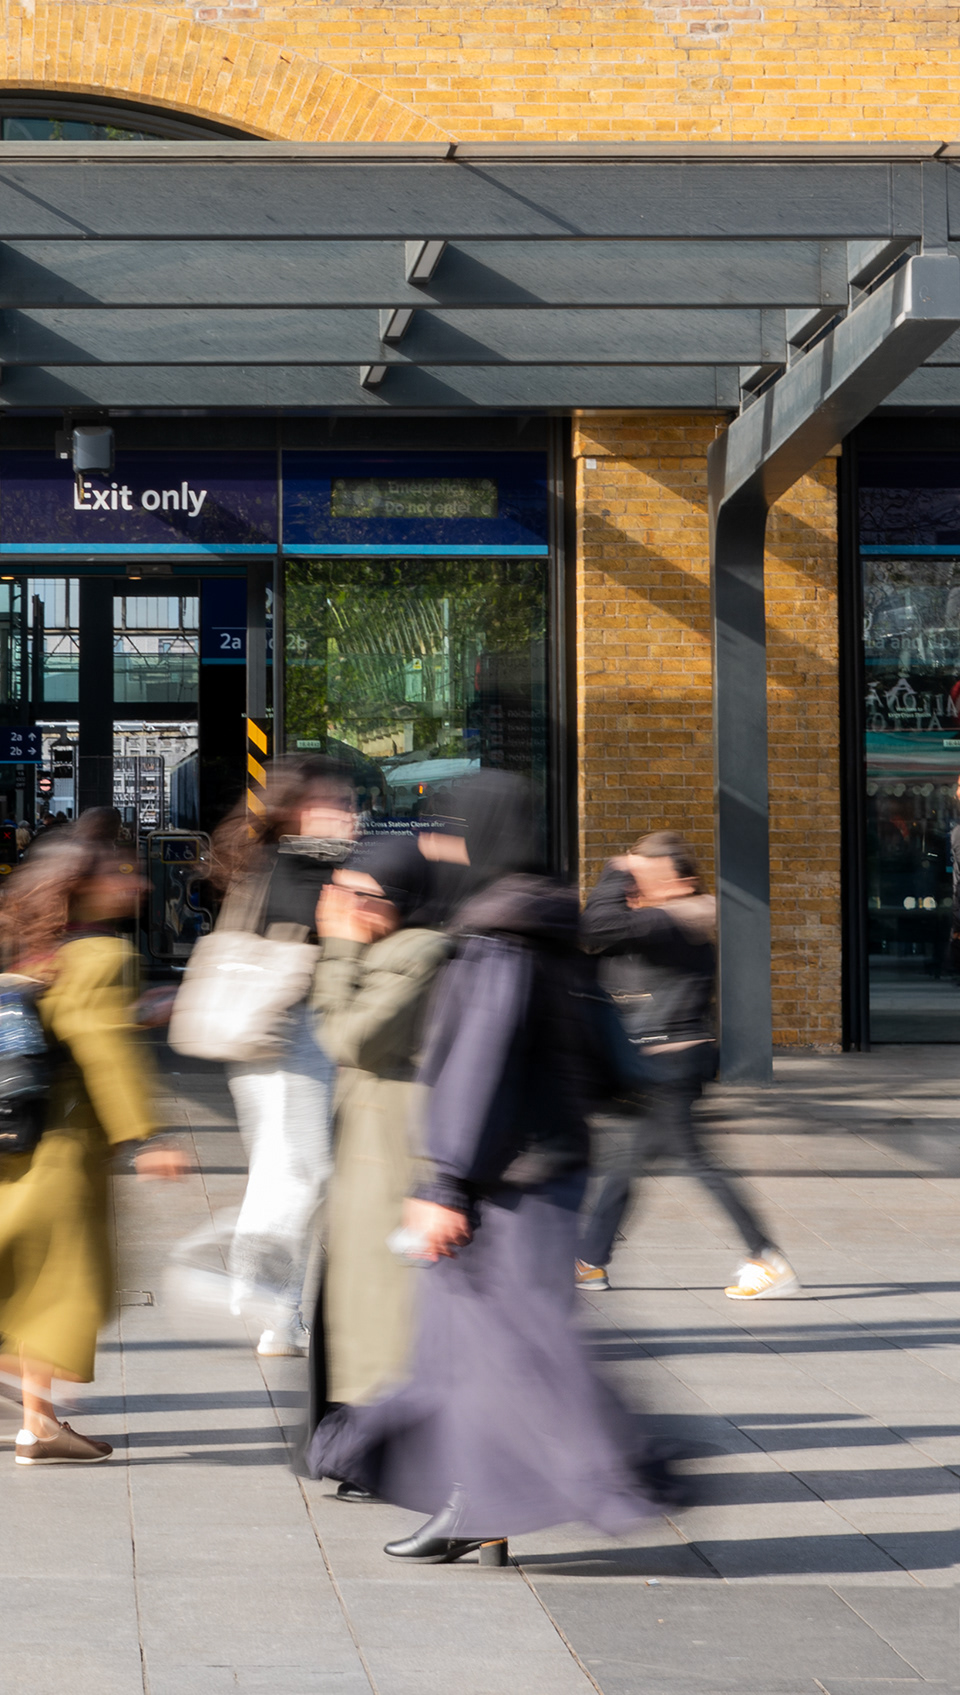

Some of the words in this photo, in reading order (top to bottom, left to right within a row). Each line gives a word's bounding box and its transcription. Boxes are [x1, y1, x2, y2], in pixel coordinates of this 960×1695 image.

[388, 481, 466, 498] Emergency
[73, 481, 133, 511] Exit
[141, 482, 207, 517] only
[385, 500, 405, 513] Do
[407, 500, 432, 513] not
[434, 500, 470, 514] enter
[220, 633, 242, 650] 2a
[10, 732, 23, 742] 2a
[10, 747, 23, 756] 2b
[370, 820, 387, 828] Cross
[387, 820, 410, 828] Station
[410, 820, 430, 828] Closes
[430, 819, 445, 828] after
